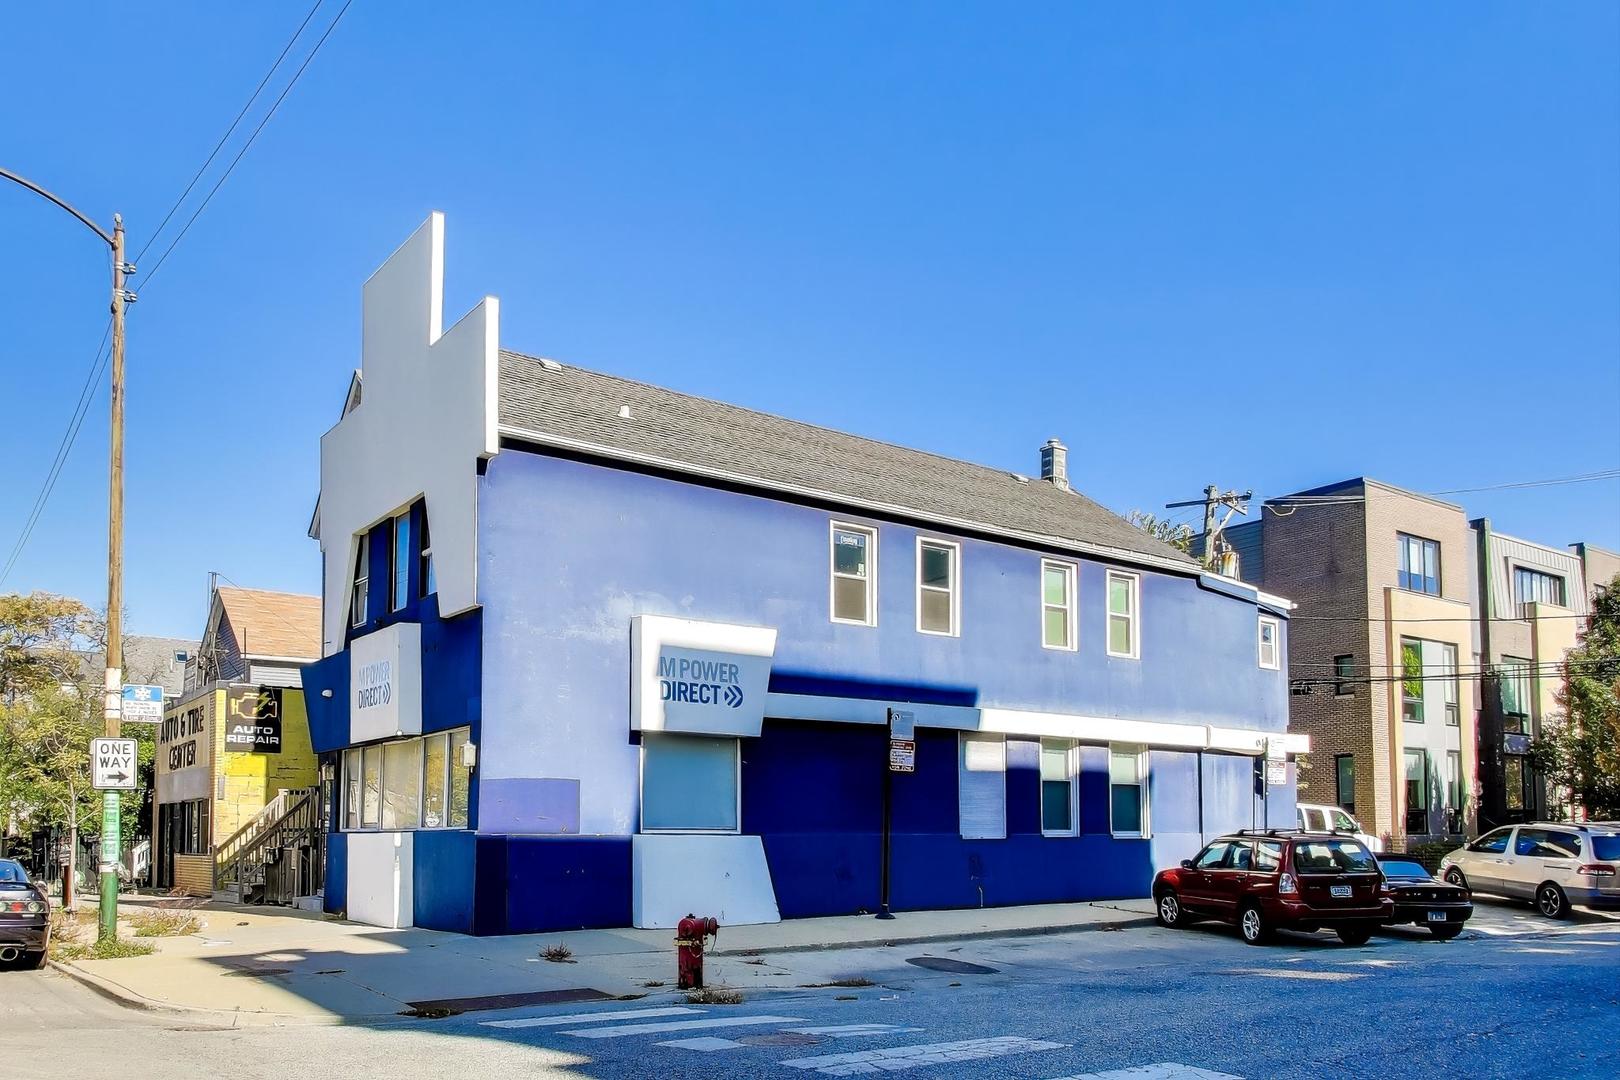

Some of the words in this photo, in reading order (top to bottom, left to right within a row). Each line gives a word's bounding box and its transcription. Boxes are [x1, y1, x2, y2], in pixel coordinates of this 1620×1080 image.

[358, 685, 382, 709] DIRECT
[661, 680, 721, 705] DIRECT
[160, 716, 179, 744] AUTO
[187, 705, 205, 736] TIRE
[232, 725, 274, 735] AUTO
[226, 734, 280, 745] REPAIR
[100, 743, 131, 755] ONE
[169, 739, 197, 771] CENTER
[99, 756, 132, 769] WAY
